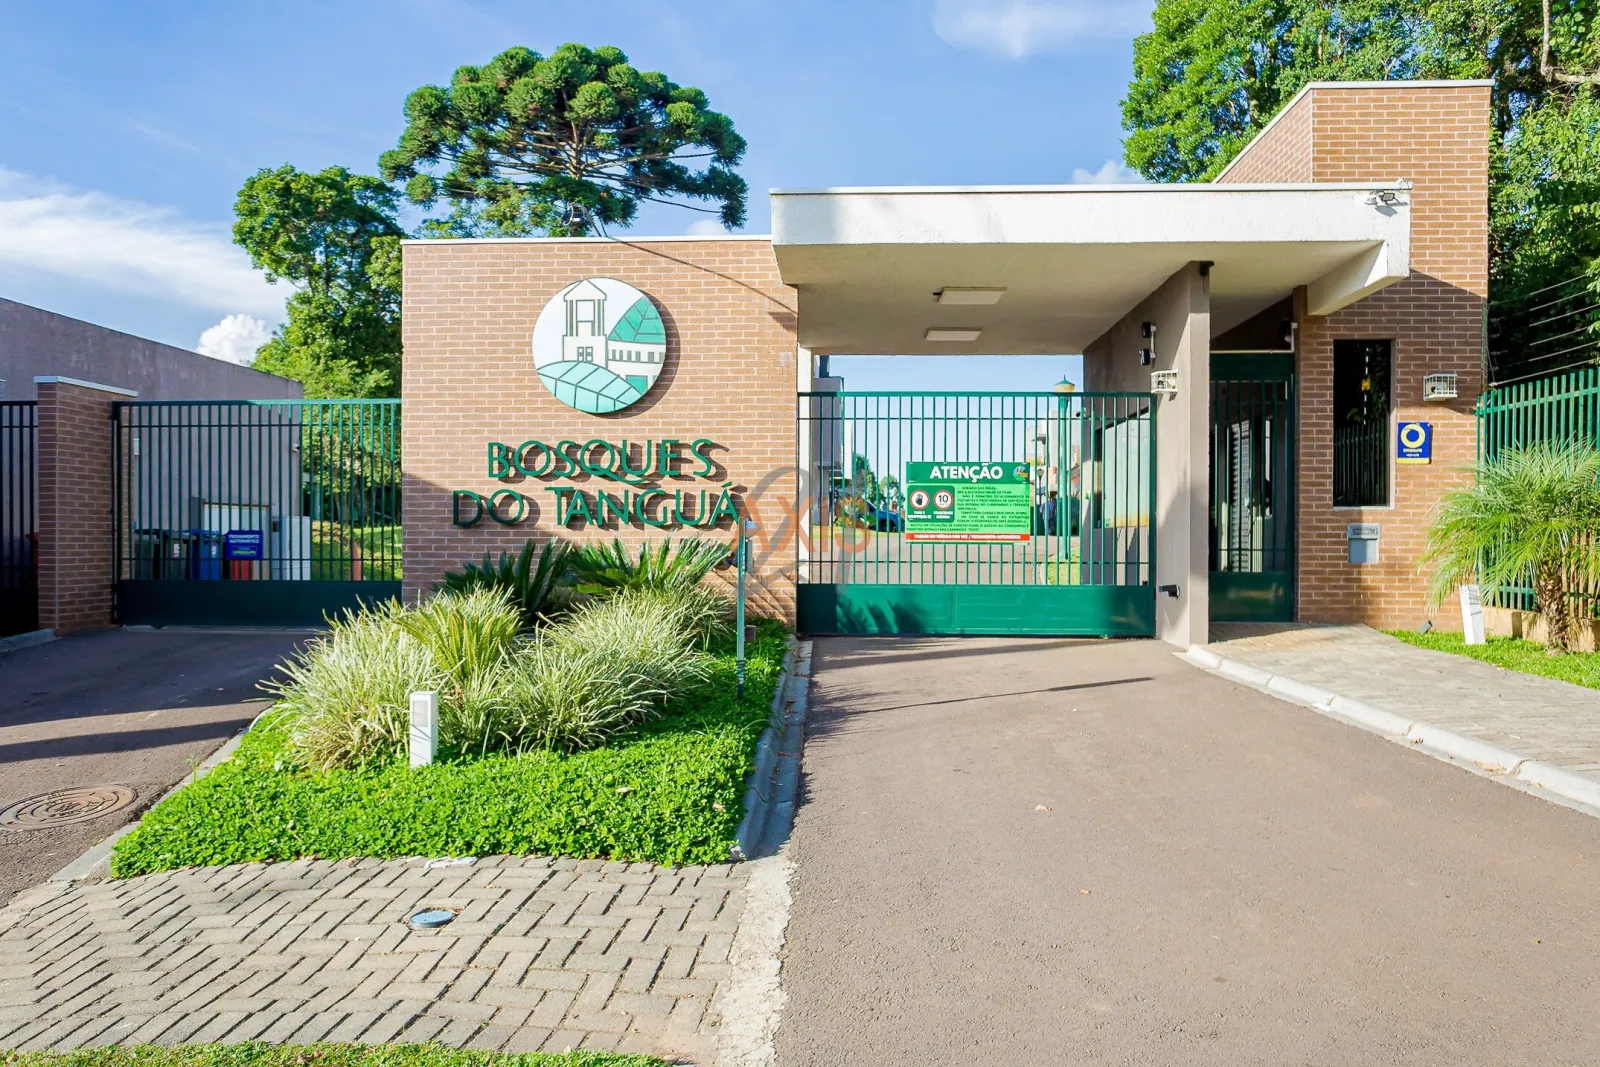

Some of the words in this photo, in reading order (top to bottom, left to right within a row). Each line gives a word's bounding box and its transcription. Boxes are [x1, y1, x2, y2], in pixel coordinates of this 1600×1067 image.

[487, 438, 713, 485] BOSQUES
[929, 463, 1004, 483] ATENÇÃO
[452, 489, 525, 527] DO
[545, 482, 741, 527] TANGUÁ
[938, 494, 949, 503] 10
